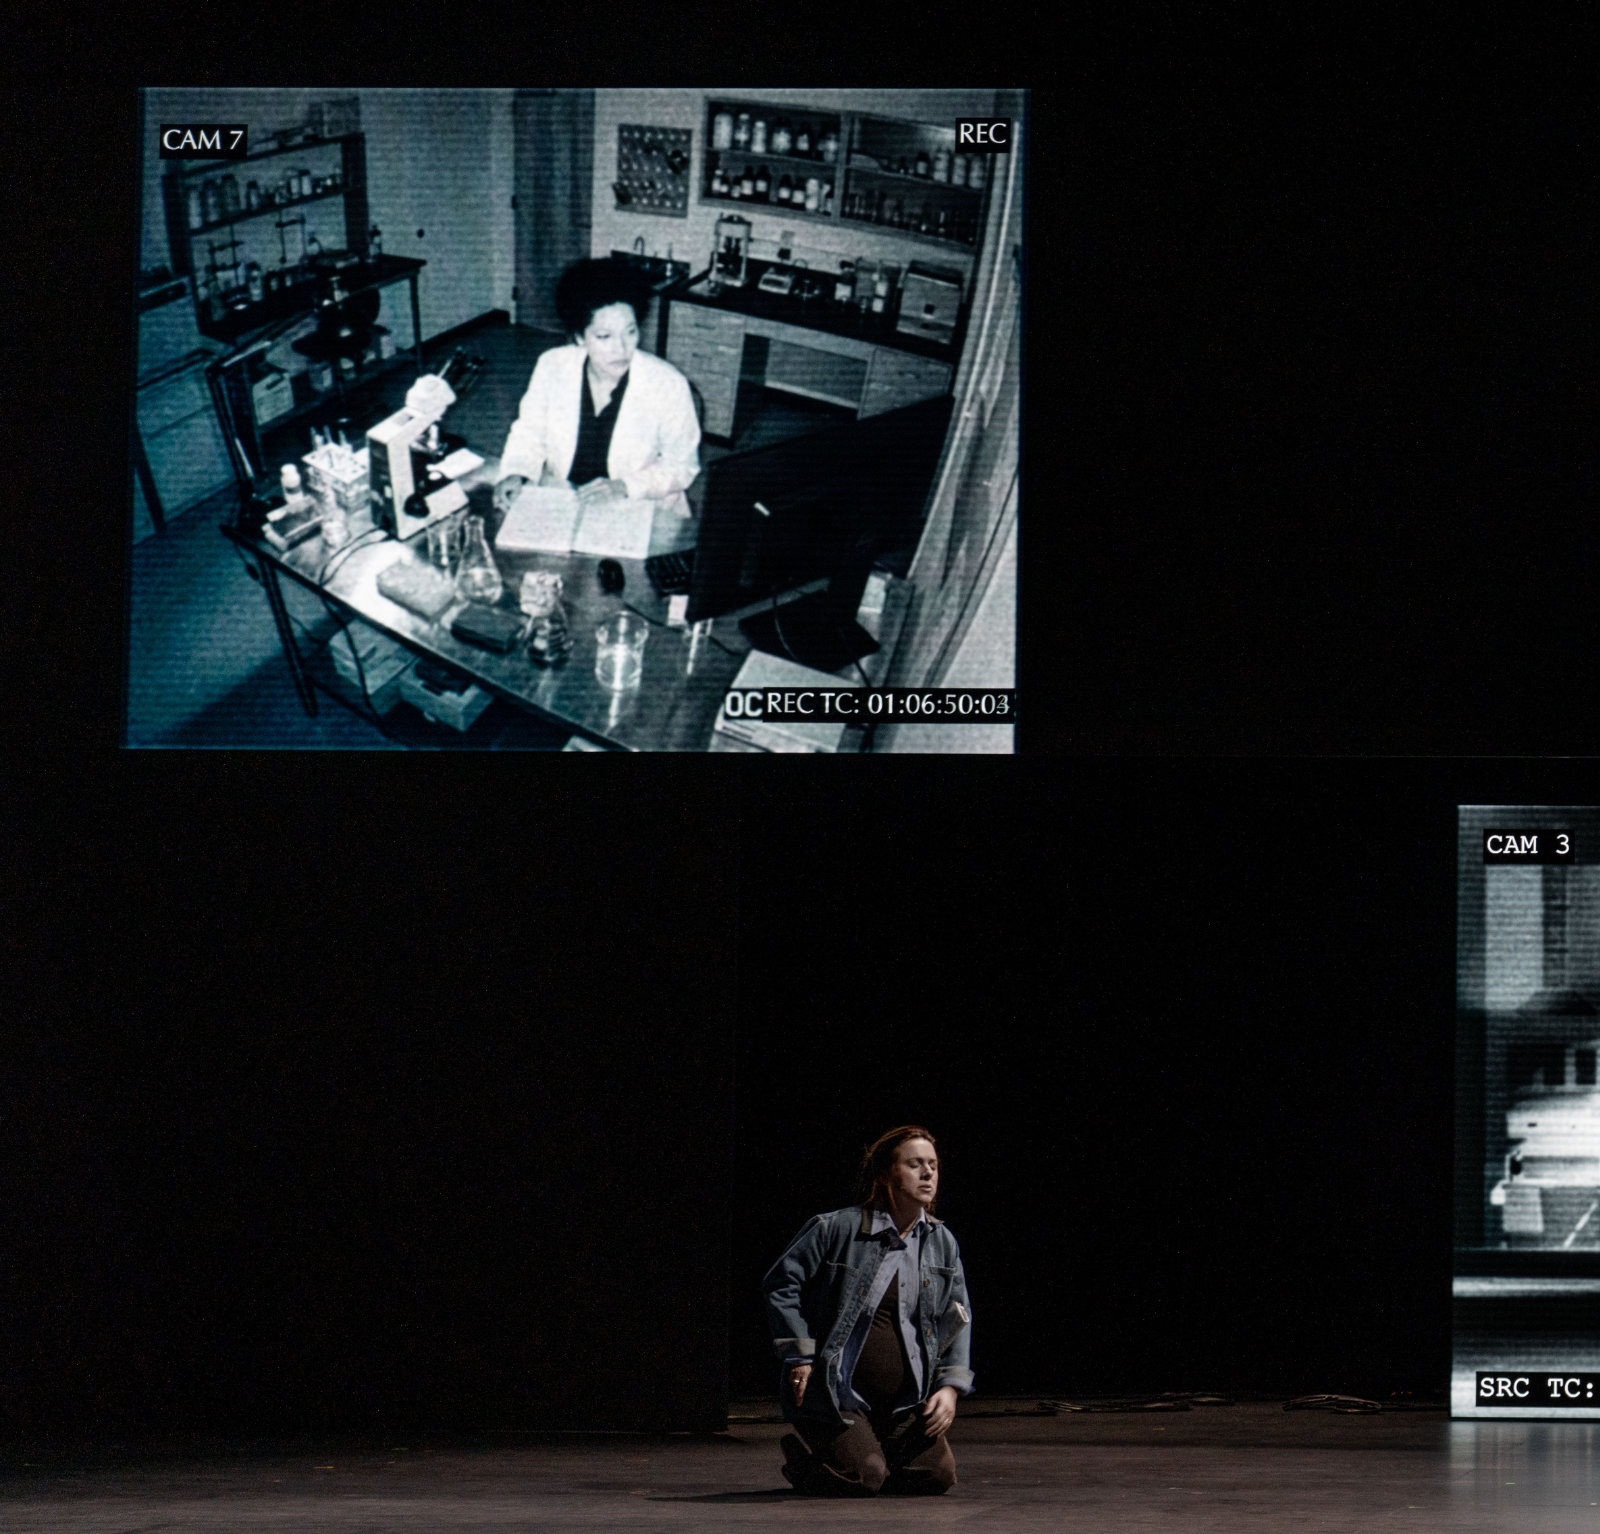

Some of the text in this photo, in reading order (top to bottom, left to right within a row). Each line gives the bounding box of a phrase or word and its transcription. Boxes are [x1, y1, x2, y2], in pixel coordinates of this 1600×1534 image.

[163, 129, 244, 151] CAM 7
[960, 122, 1008, 144] REC
[725, 690, 763, 717] OC
[767, 692, 815, 714] REC
[819, 693, 860, 714] TC:
[1486, 833, 1570, 855] CAM 3
[1479, 1377, 1530, 1397] SRC
[1547, 1378, 1594, 1398] TC:
